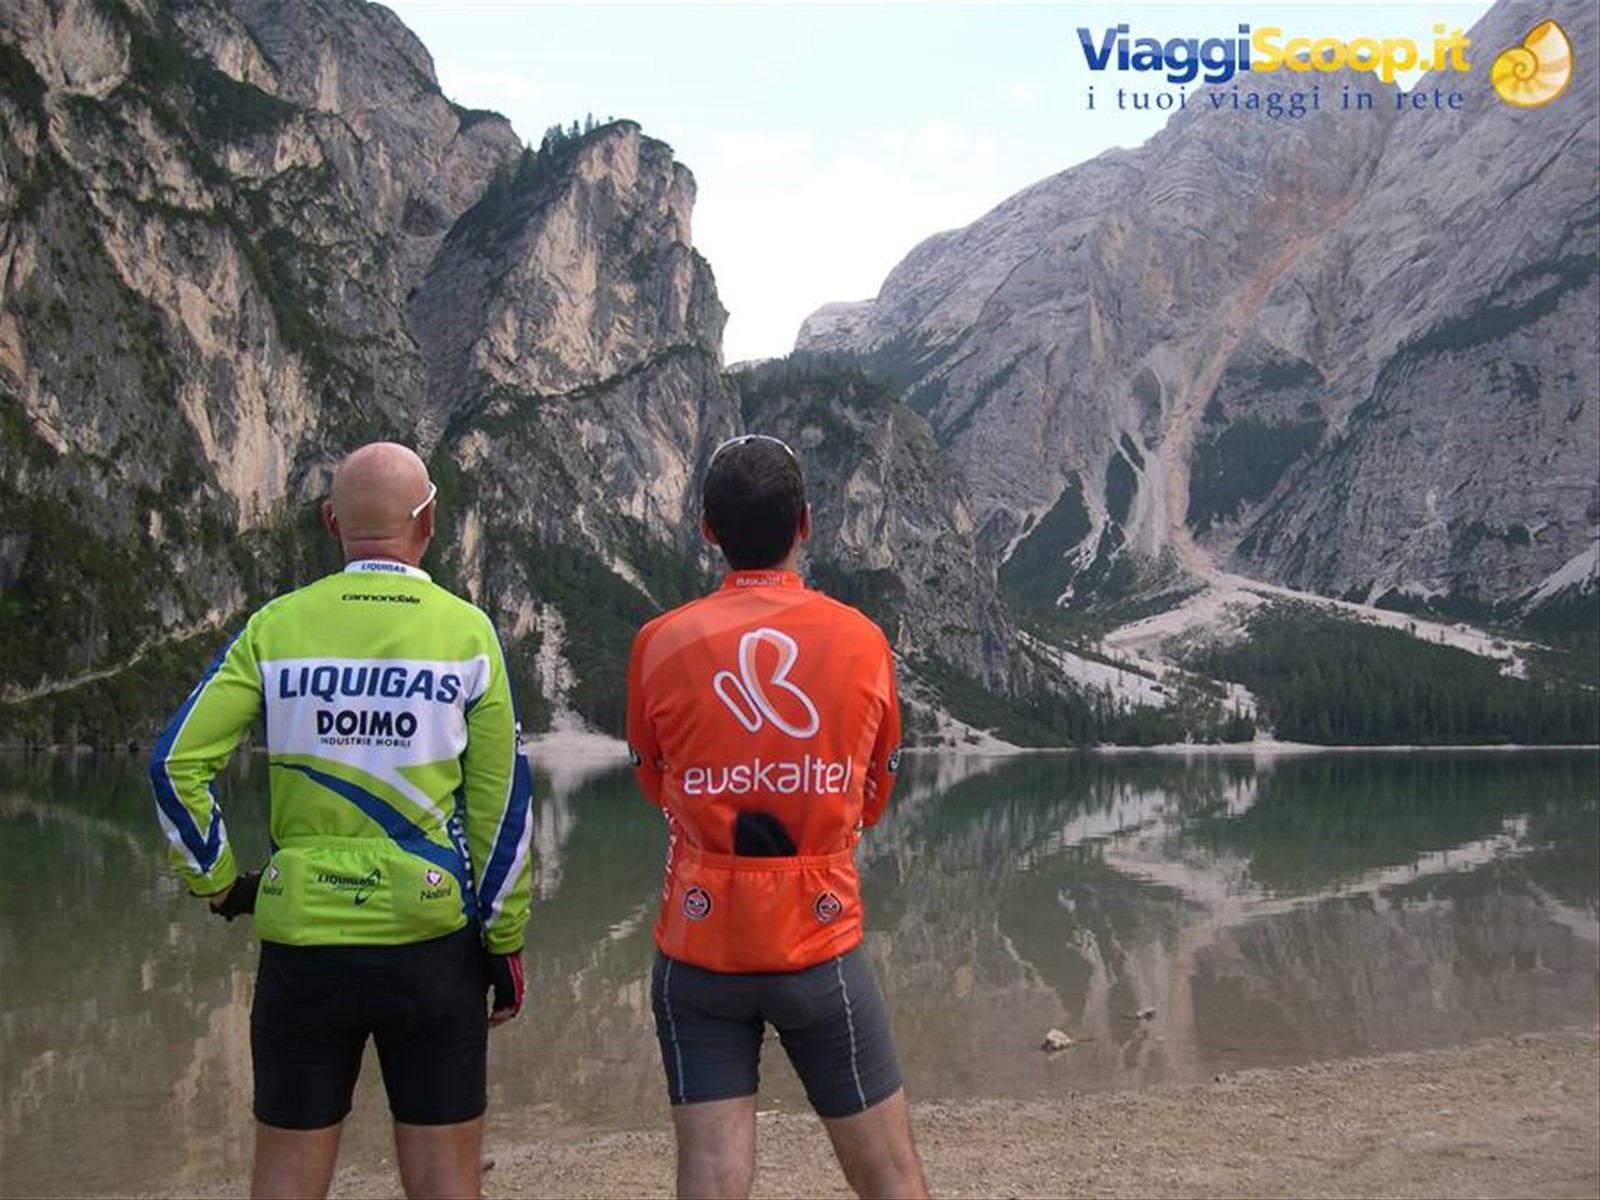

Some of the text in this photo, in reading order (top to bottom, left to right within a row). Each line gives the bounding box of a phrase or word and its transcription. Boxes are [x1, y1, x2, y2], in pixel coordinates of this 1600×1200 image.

[279, 666, 461, 704] LIQUIGAS
[316, 709, 418, 738] DOIMO
[320, 737, 371, 746] INDUSTRIE
[683, 754, 852, 794] euskaltel
